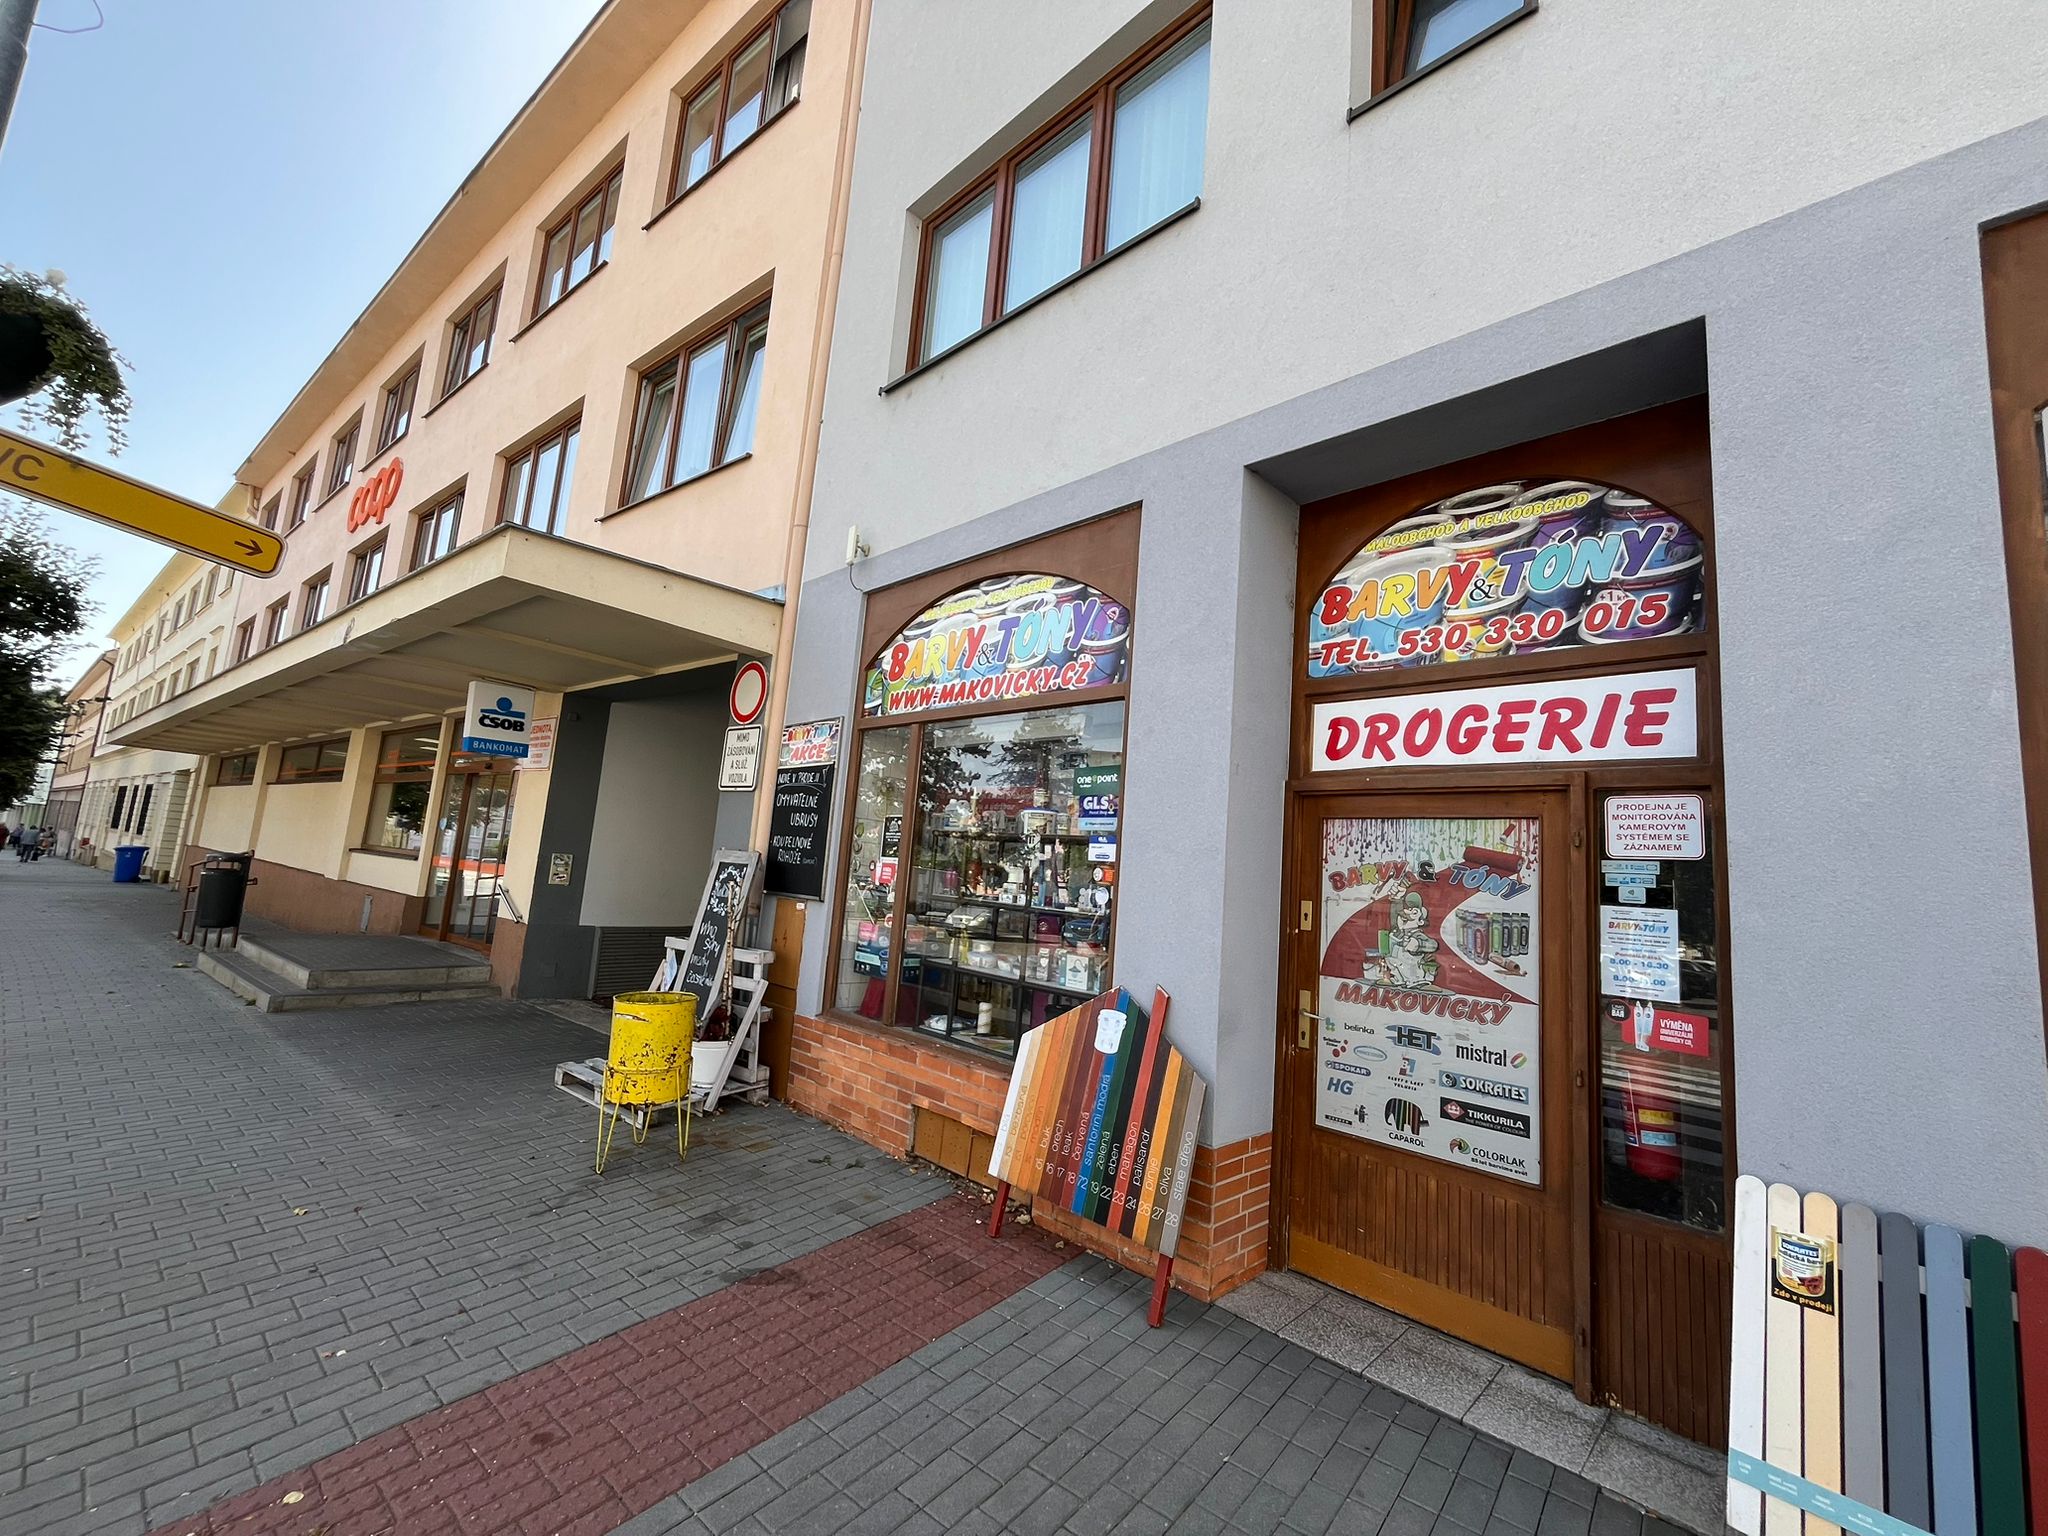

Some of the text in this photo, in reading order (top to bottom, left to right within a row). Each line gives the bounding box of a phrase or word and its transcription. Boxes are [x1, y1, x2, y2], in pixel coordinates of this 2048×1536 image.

[347, 456, 404, 534] coop
[1364, 491, 1590, 553] MALOOBCHOD A VELKOOBCHOD
[1319, 525, 1665, 626] BARVY & TÓNY
[888, 598, 1099, 683] BARVY & TÓNY
[1320, 593, 1670, 667] TEL. 530 330 015
[888, 661, 1094, 712] WWW.MAKOVICKY.CZ
[478, 713, 526, 732] ČSOB
[1324, 687, 1678, 762] DROGERIE
[472, 740, 524, 754] BANKOMAT
[736, 732, 750, 742] MIMO
[790, 743, 827, 762] AKCE
[730, 760, 734, 770] A
[728, 773, 748, 784] VOZIDLA
[1083, 796, 1109, 810] GLS
[1616, 802, 1687, 811] PRODEJNA JE
[790, 812, 818, 828] UBRUSY
[1616, 832, 1690, 841] SYSTÉMEM SE
[1623, 842, 1682, 851] ZÁZNAMEM
[1328, 860, 1532, 900] BARVY & TÓNY
[1608, 921, 1640, 932] BARVY
[1334, 981, 1512, 1026] MAKOVICKÝ
[1612, 1010, 1624, 1018] BAR
[1344, 1022, 1375, 1034] belinka
[1660, 1018, 1693, 1032] VÝMĚNA
[1397, 1026, 1437, 1050] HET
[1456, 1044, 1507, 1068] mistral
[1334, 1062, 1368, 1076] SPOKAR
[1327, 1076, 1354, 1096] HG
[1460, 1076, 1526, 1100] SOKRATES
[1467, 1108, 1524, 1130] TIKKURILA
[1040, 1127, 1051, 1148] buk
[1067, 1111, 1090, 1184] 18 červená
[1388, 1132, 1425, 1148] CAPAROL
[1057, 1131, 1074, 1178] 17 teak
[1076, 1174, 1089, 1190] 72
[1084, 1112, 1104, 1167] santorini
[1090, 1130, 1111, 1194] 19 zelená
[1472, 1147, 1526, 1168] COLORLAK
[1046, 1162, 1056, 1175] 16
[1099, 1142, 1120, 1200] 22 eben
[1112, 1120, 1138, 1206] 23 mahagon
[1125, 1128, 1150, 1210] 24 palisandr
[1164, 1211, 1179, 1228] 28
[1180, 1131, 1194, 1168] dřevo
[1152, 1166, 1172, 1220] 27 oliva
[1774, 1287, 1791, 1299] Zde
[1799, 1297, 1833, 1312] prodeji
